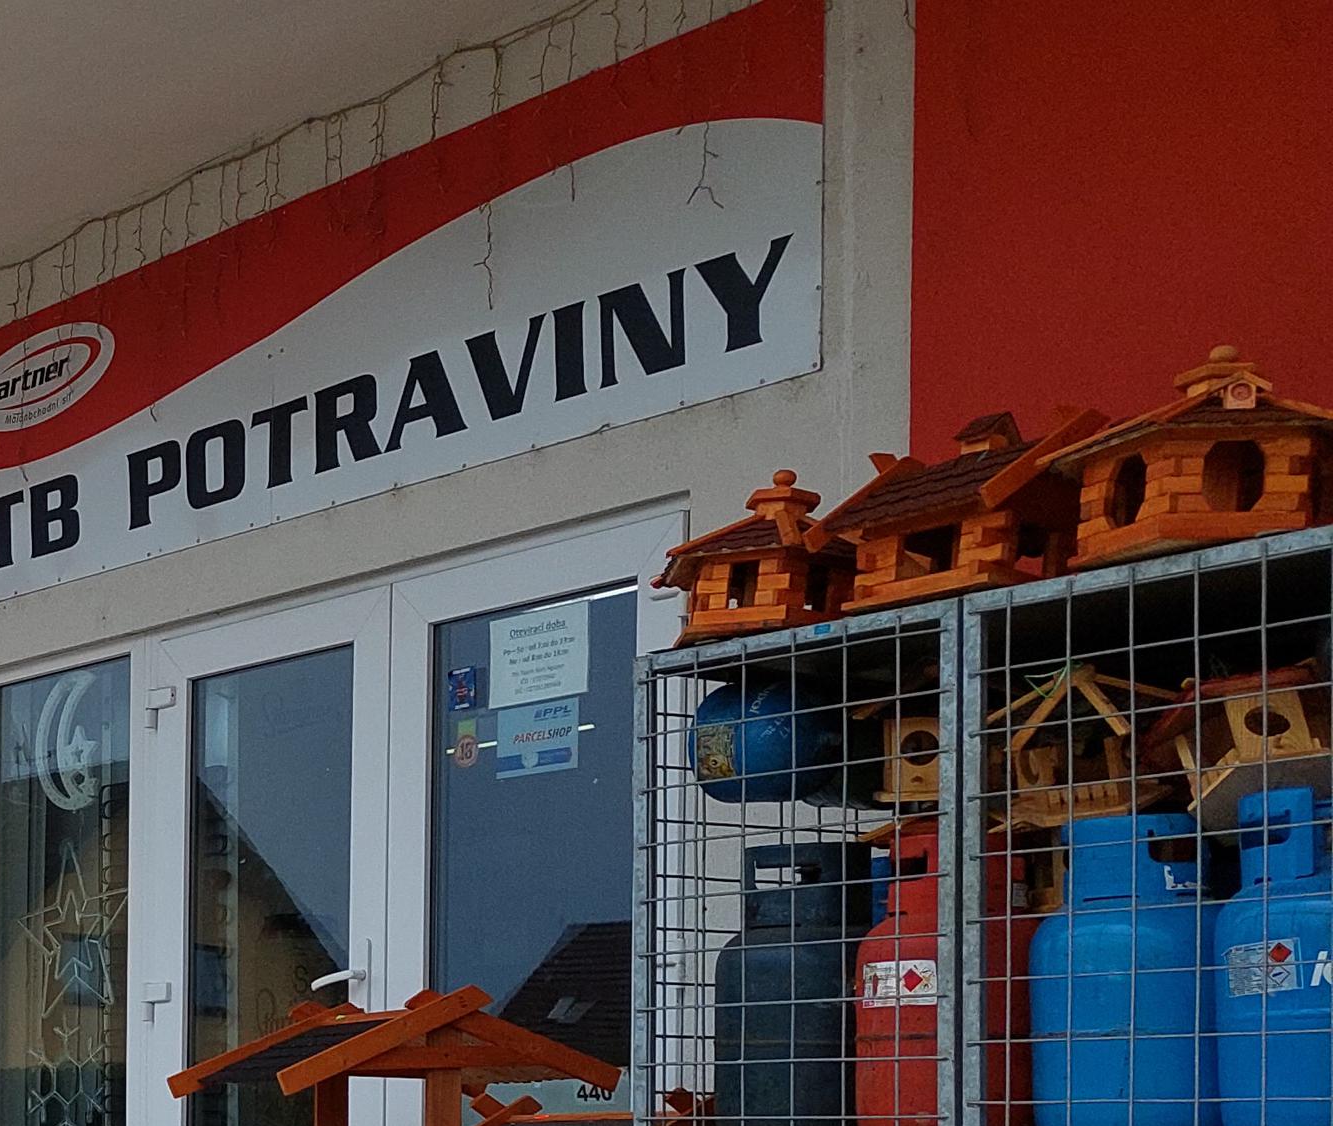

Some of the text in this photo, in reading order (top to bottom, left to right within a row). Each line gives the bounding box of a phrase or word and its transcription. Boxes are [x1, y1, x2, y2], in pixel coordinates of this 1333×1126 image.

[126, 232, 794, 530] POTRAVINY
[543, 704, 573, 718] PPL
[513, 725, 573, 745] PARCELSHOP
